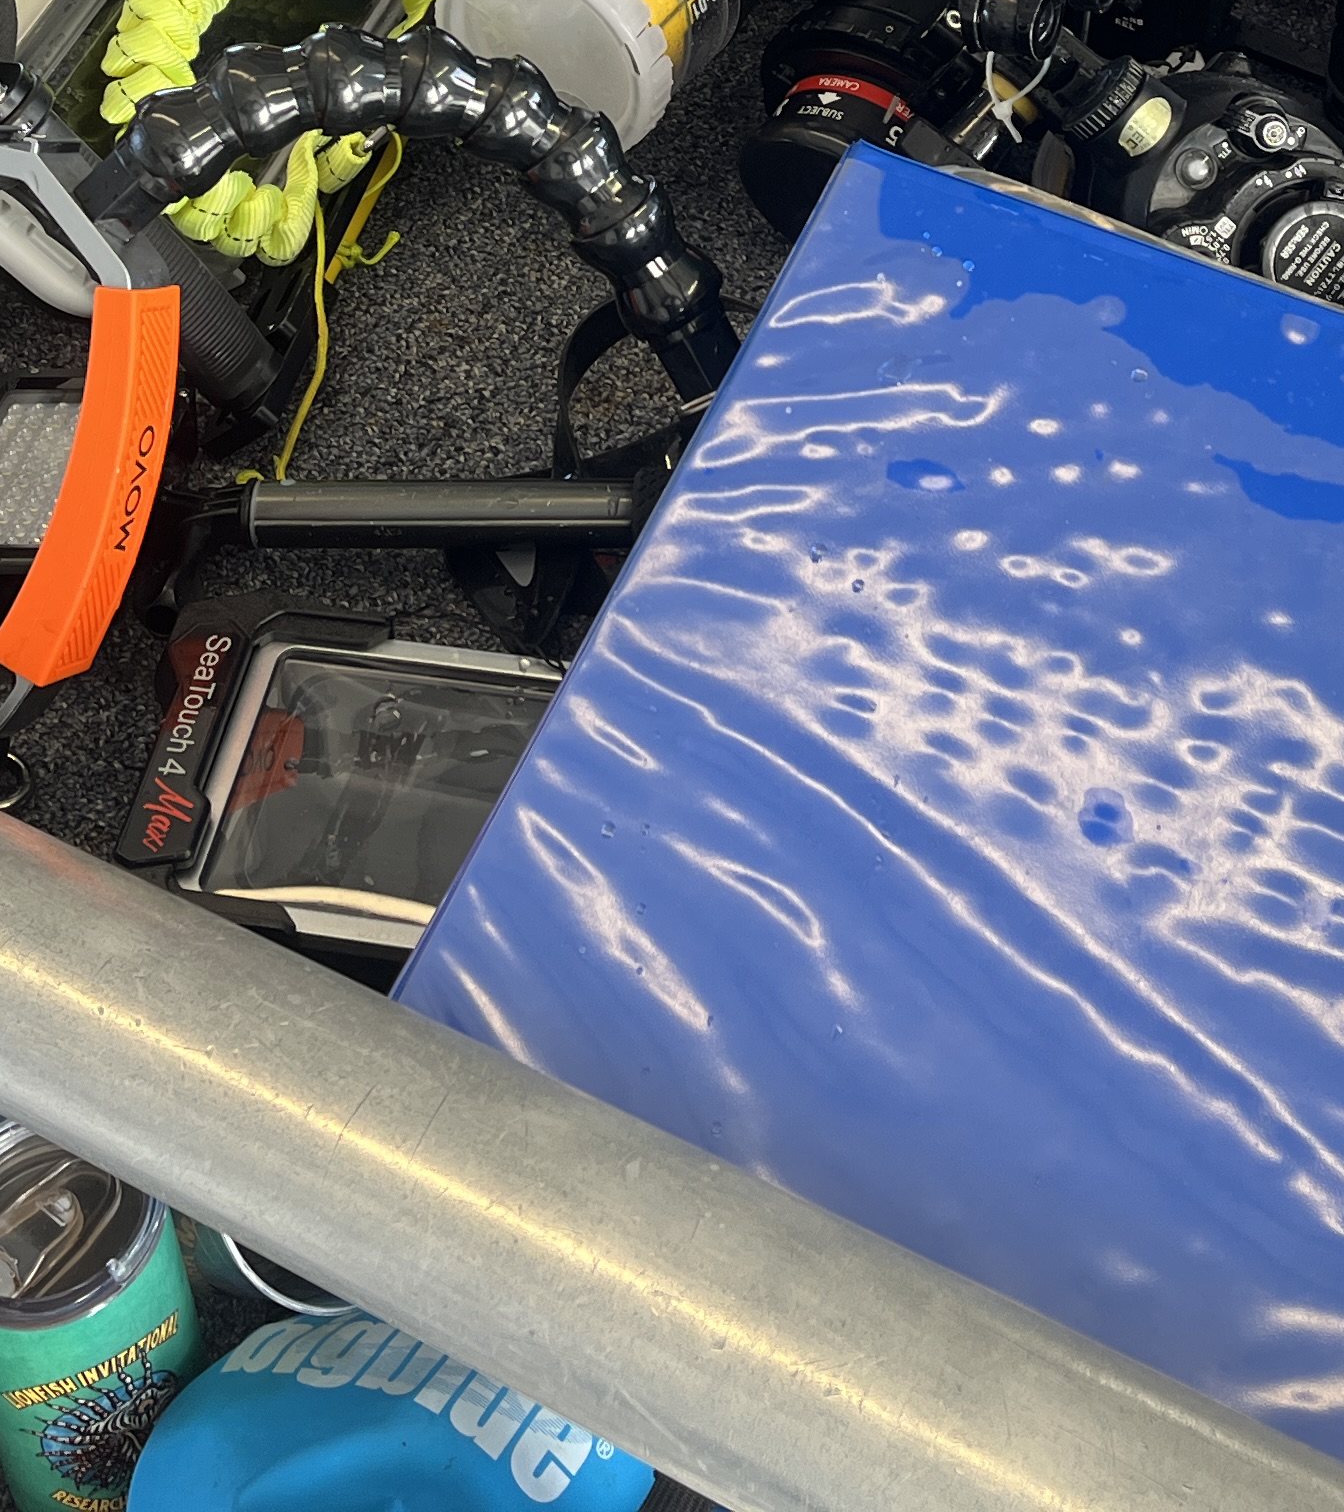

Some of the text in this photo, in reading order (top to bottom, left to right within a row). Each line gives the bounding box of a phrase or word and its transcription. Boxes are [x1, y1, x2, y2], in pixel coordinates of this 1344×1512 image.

[818, 77, 860, 91] CAMERA
[797, 105, 844, 120] SUBJECT
[1311, 221, 1330, 243] CHECK
[1299, 242, 1313, 258] THE
[1309, 235, 1331, 261] BEFORE
[1305, 242, 1342, 287] CAUTION
[113, 424, 155, 552] MOVO
[142, 633, 232, 853] SeaTouch 4 Max
[1, 1308, 182, 1411] LIONFISH INVITATIONAL
